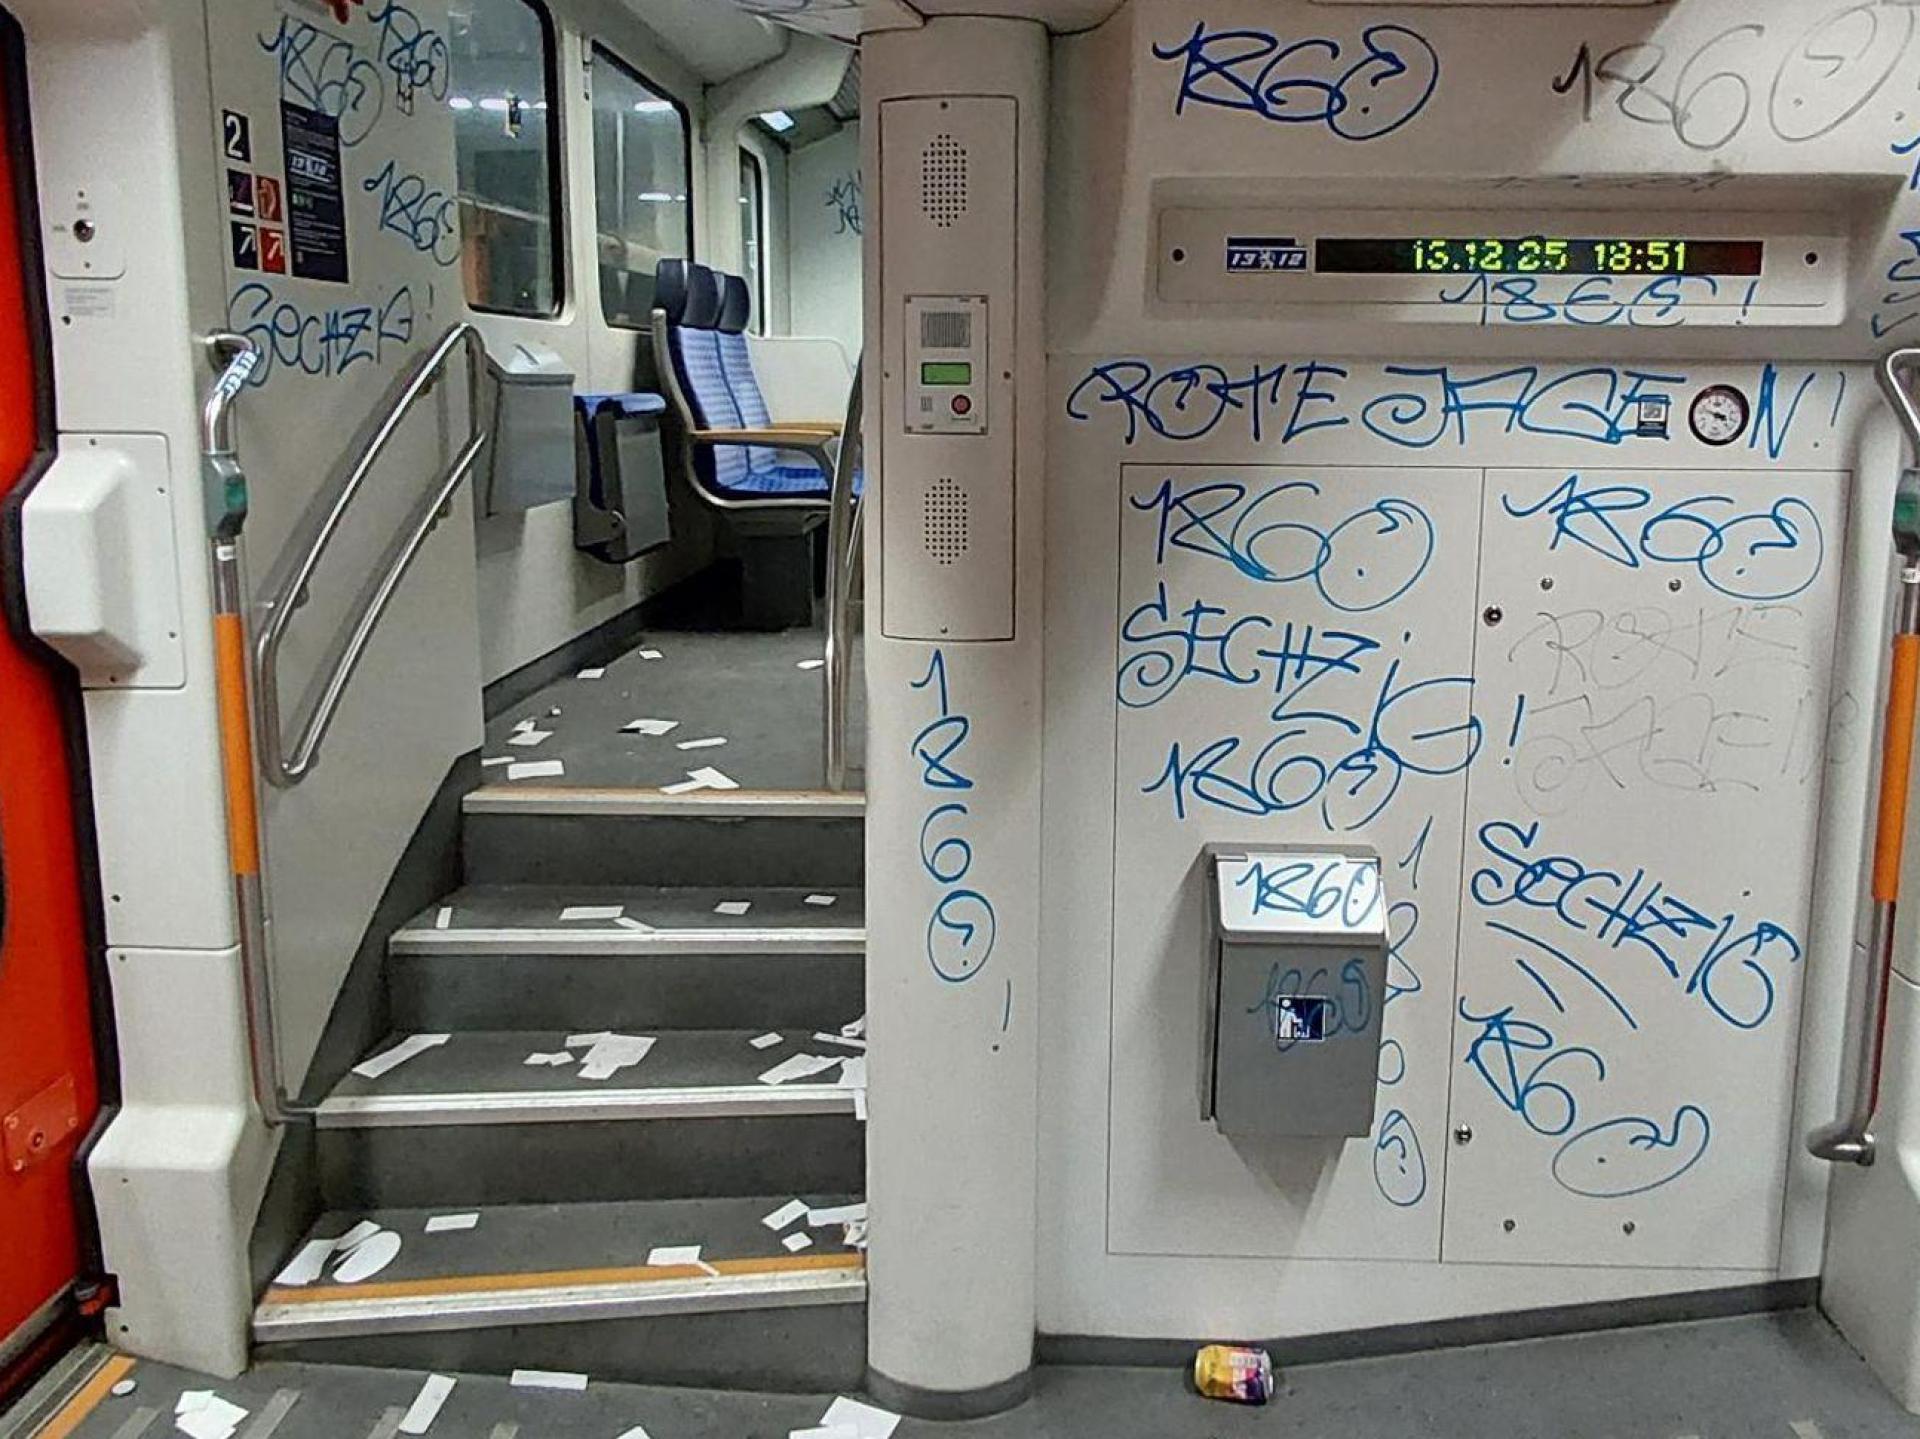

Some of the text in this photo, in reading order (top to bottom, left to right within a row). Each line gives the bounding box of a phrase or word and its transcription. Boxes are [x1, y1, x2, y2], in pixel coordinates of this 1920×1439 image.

[1152, 20, 1439, 141] 1860
[226, 114, 243, 158] 2
[1594, 241, 1686, 271] 18:51
[1066, 361, 1351, 444] ROTE
[1130, 478, 1433, 612] 1860
[1503, 474, 1824, 600] 1860
[1235, 861, 1380, 927] 1860
